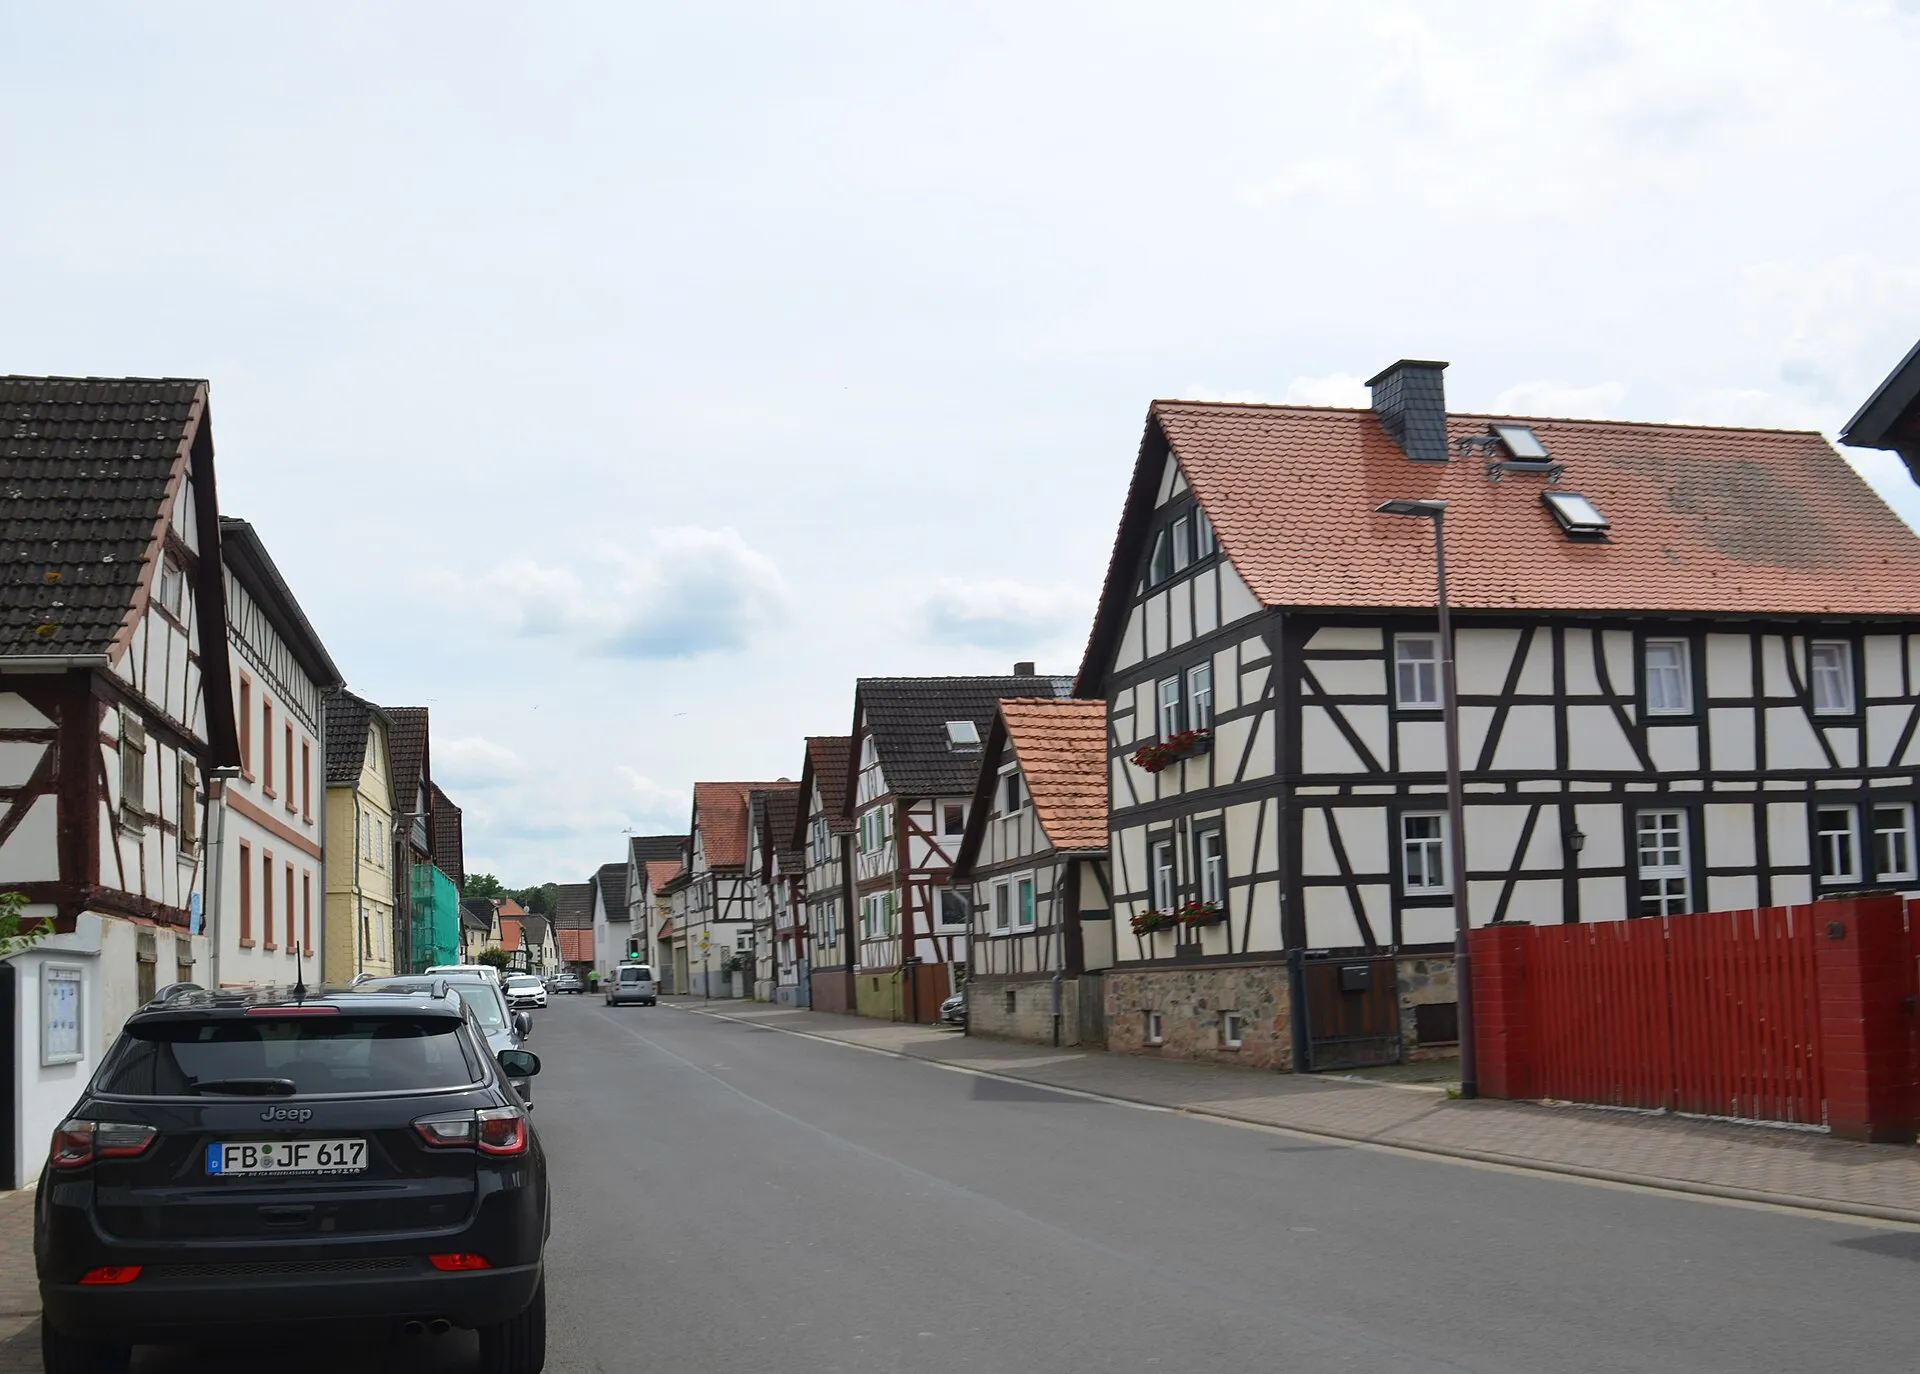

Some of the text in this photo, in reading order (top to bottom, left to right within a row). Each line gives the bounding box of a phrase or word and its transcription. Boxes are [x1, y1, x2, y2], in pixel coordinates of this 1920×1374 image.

[260, 1106, 312, 1123] Jeep
[211, 1160, 219, 1169] D
[225, 1143, 364, 1169] FB JF 617
